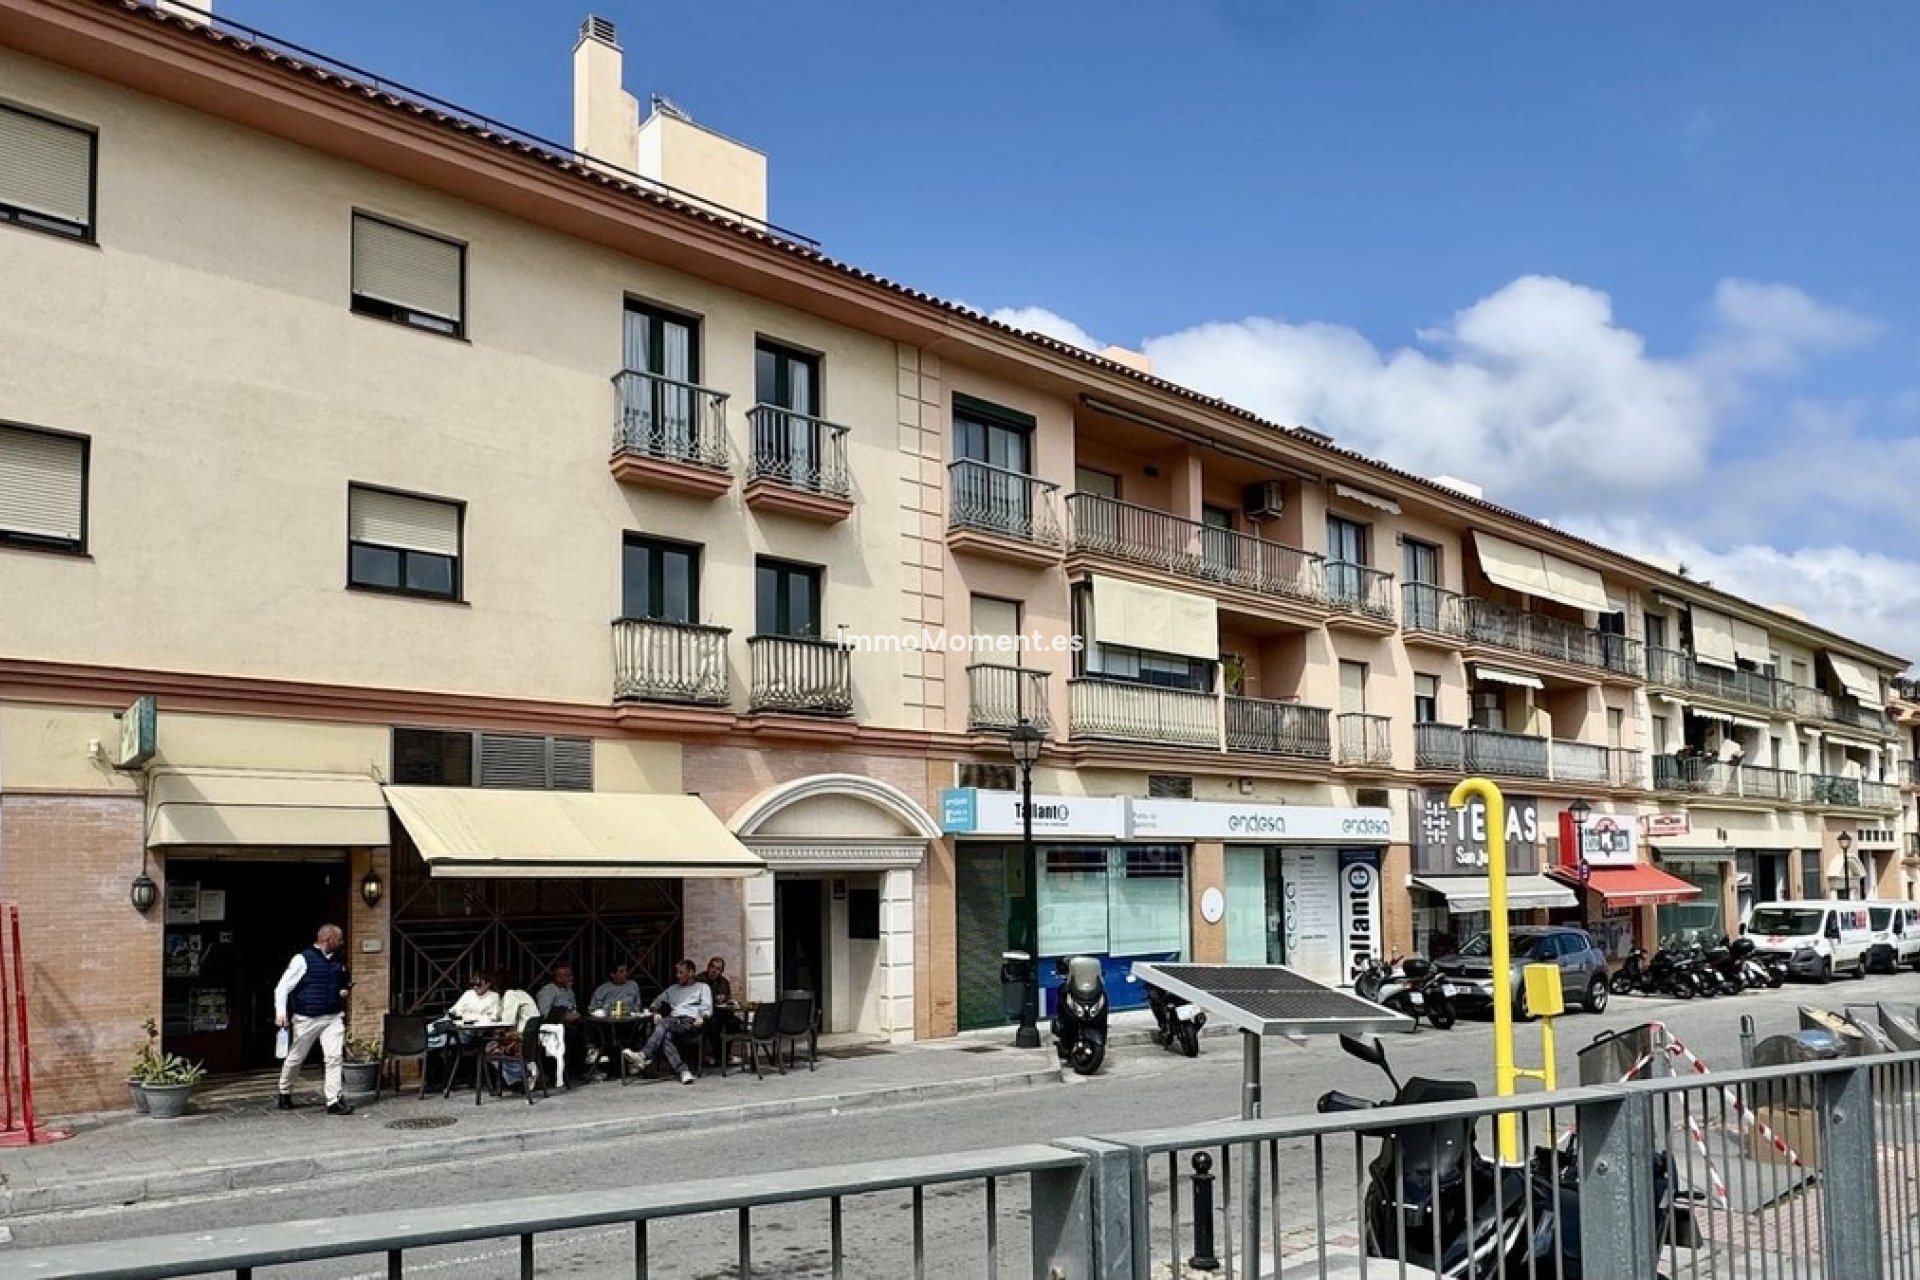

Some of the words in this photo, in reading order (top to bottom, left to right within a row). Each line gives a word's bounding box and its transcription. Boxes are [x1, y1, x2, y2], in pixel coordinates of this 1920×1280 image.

[1228, 812, 1285, 832] endesa
[1342, 816, 1389, 834] endesa
[1456, 804, 1537, 842] TEAS
